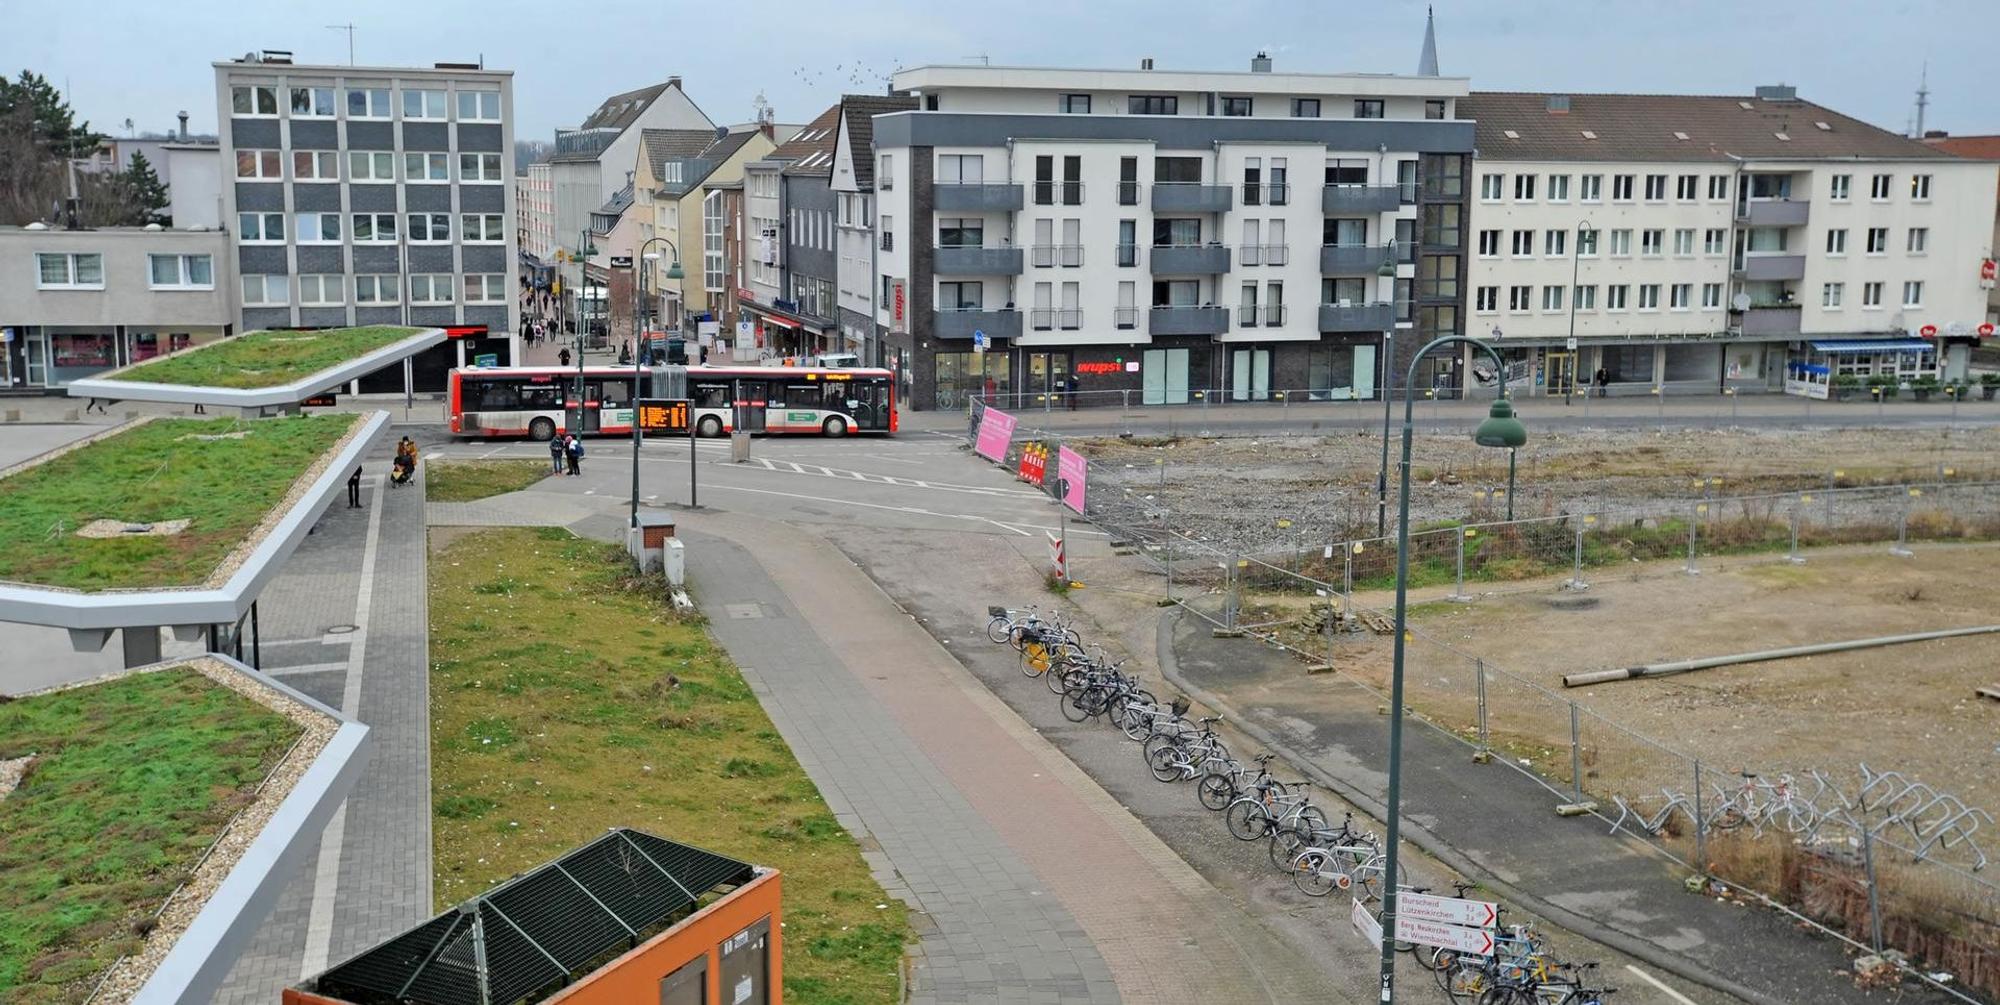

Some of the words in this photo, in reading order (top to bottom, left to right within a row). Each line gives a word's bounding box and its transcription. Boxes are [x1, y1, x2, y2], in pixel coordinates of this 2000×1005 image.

[896, 284, 904, 321] wupsi
[1077, 358, 1121, 375] wupsi
[1402, 896, 1440, 908] Burscheid
[1411, 932, 1458, 945] Wiembachtal
